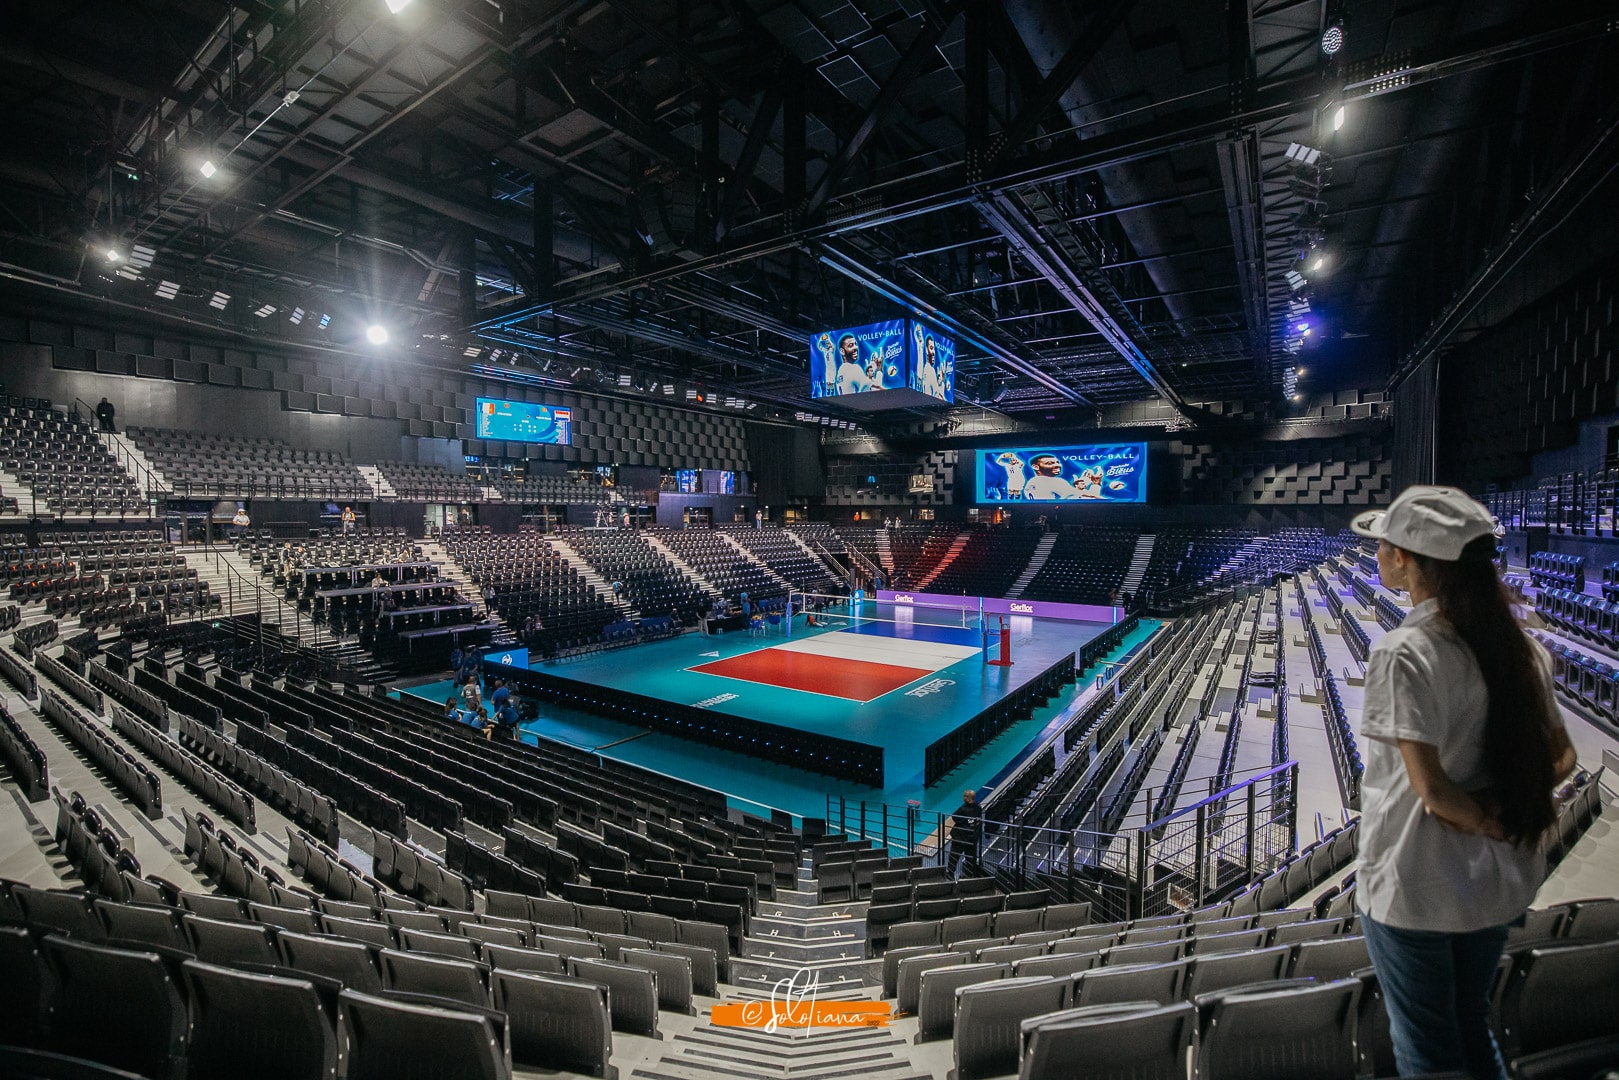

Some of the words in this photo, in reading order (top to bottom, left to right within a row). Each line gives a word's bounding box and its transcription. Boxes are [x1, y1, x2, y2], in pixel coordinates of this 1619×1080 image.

[858, 328, 902, 341] VOLLEY-BALL
[1062, 453, 1135, 462] VOLLEY-BALL
[1010, 602, 1034, 613] Gerflor
